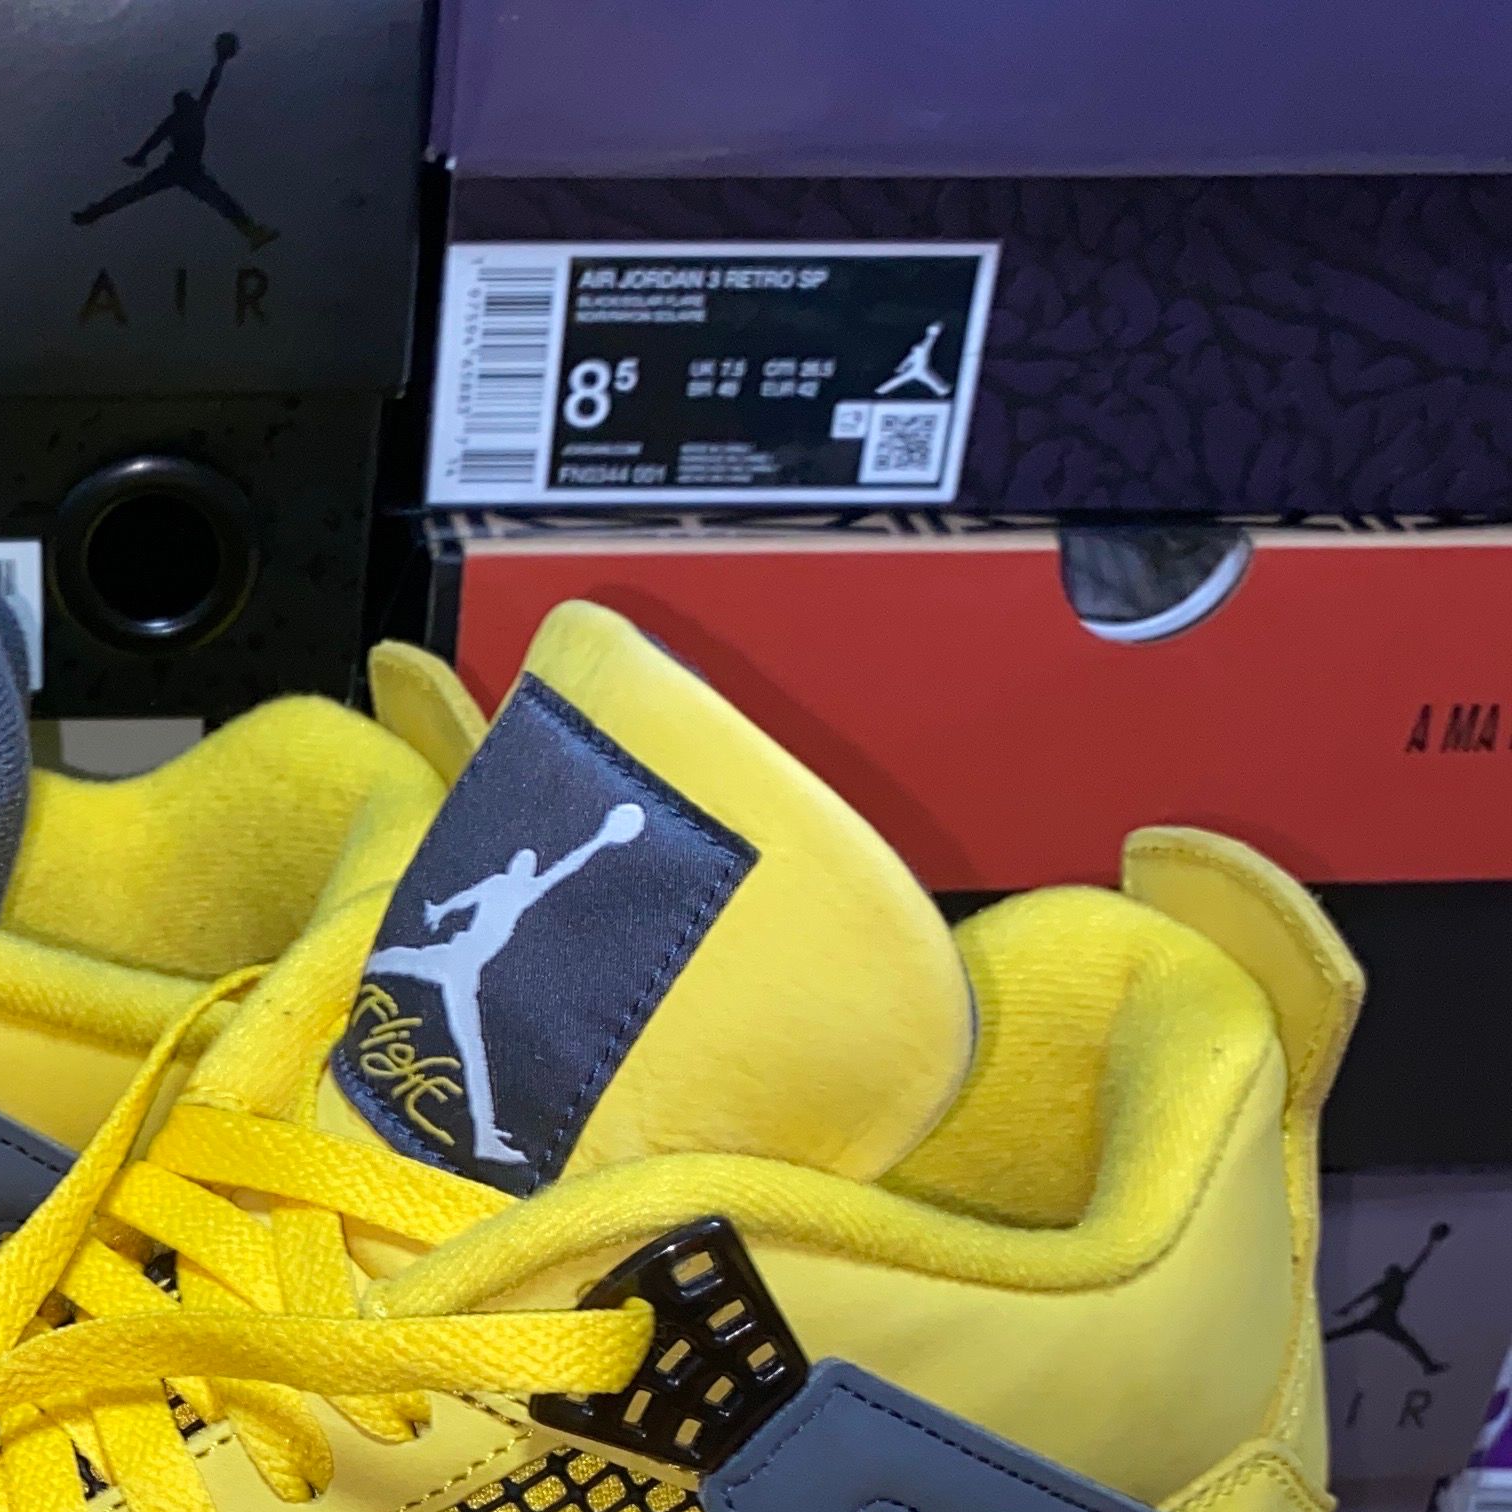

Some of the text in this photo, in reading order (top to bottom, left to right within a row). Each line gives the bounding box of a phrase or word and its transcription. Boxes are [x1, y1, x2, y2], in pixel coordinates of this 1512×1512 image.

[76, 266, 269, 328] AIR
[577, 267, 829, 289] AIR JORDAN 3 RETRO SP
[1405, 704, 1431, 753] A
[1345, 1389, 1431, 1429] IR
